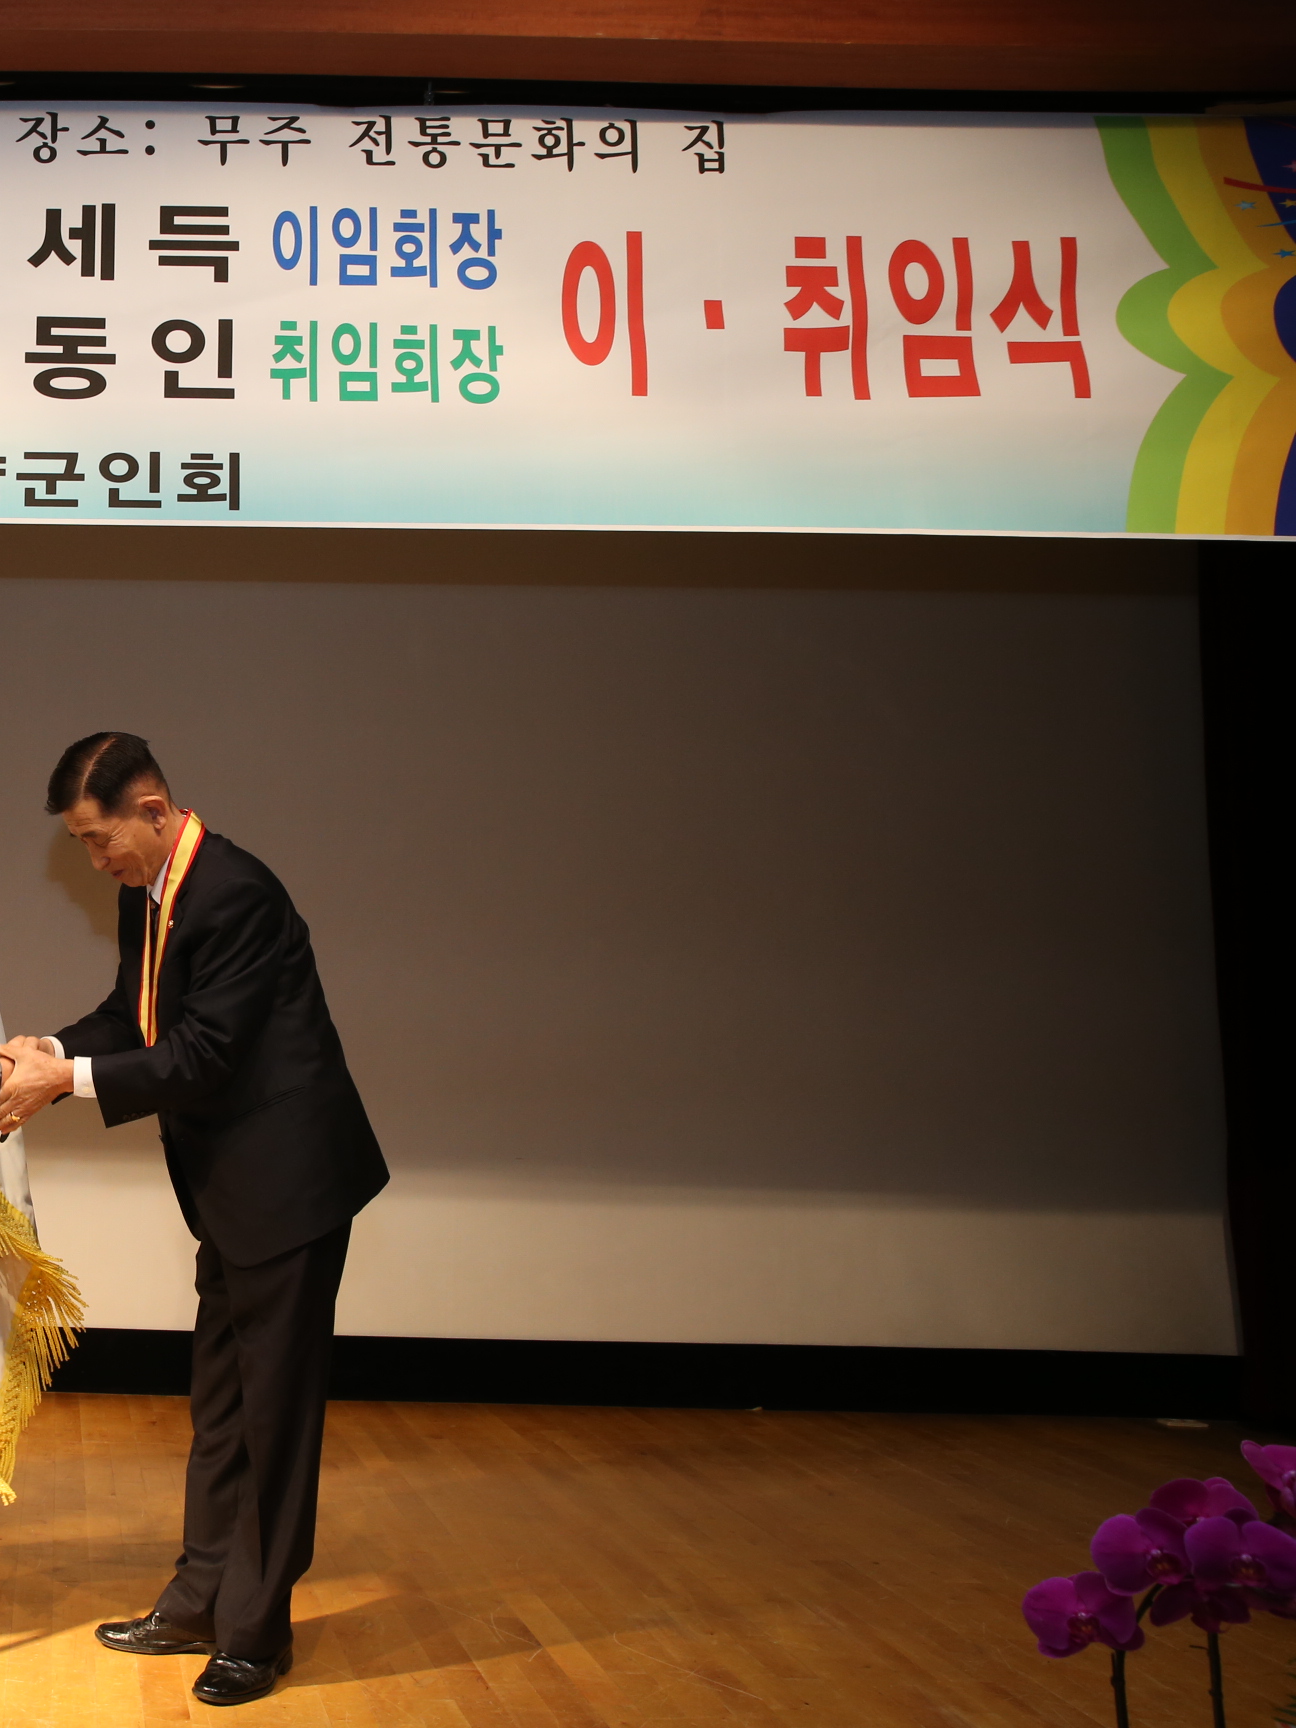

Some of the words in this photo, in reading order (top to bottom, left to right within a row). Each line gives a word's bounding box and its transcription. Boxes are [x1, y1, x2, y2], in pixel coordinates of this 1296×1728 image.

[15, 111, 157, 166] 장소:
[197, 115, 312, 168] 무주
[347, 114, 640, 175] 전통문화의
[681, 119, 726, 176] 집
[271, 206, 503, 290] 이임회장
[561, 231, 649, 397] 이
[783, 235, 1092, 401] 취임식
[270, 319, 504, 404] 취임회장
